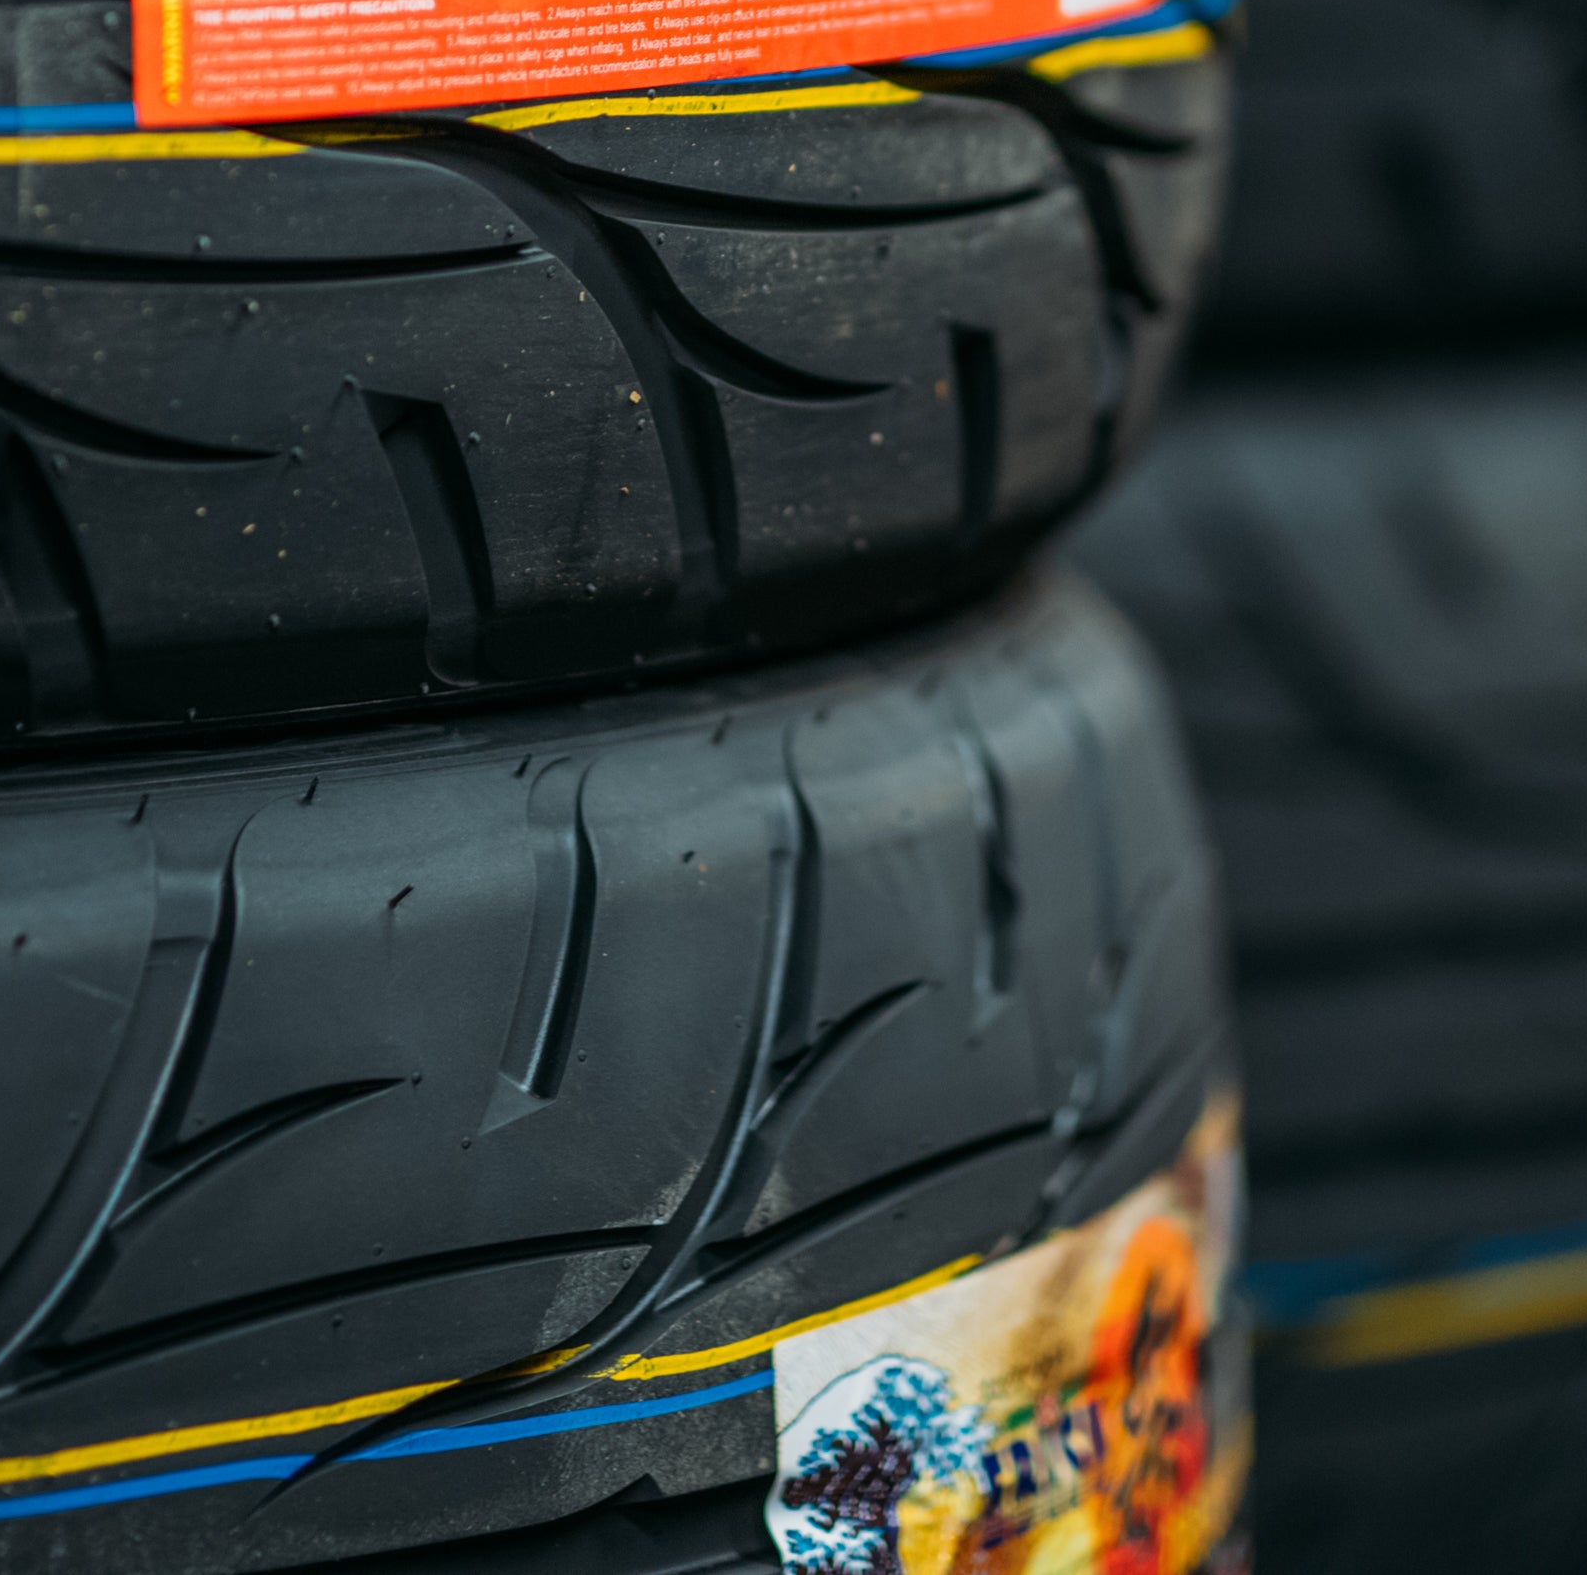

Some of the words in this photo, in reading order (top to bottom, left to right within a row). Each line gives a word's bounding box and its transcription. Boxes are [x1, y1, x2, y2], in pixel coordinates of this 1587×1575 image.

[298, 2, 346, 20] SAFETY
[466, 12, 483, 26] and
[486, 10, 519, 25] inflating
[547, 5, 585, 20] 2.Always
[587, 1, 612, 16] match
[614, 0, 627, 14] rim
[515, 27, 532, 41] and
[533, 24, 570, 40] lubricate
[572, 23, 585, 36] rim
[587, 21, 603, 35] and
[605, 20, 618, 34] tire
[620, 18, 647, 32] beads.
[653, 15, 689, 30] 6.Always
[690, 15, 704, 26] use
[755, 5, 770, 19] and
[478, 50, 503, 67] place
[516, 46, 541, 62] safety
[543, 47, 563, 60] cage
[566, 43, 588, 56] when
[591, 39, 625, 55] inflating.
[632, 36, 667, 51] 8.Always
[669, 32, 691, 47] stand
[717, 28, 731, 42] and
[496, 67, 527, 82] vehicle
[528, 62, 588, 79] manufacture's
[590, 56, 657, 74] recommendation
[658, 54, 676, 68] after
[677, 51, 701, 66] beads
[703, 53, 716, 63] are
[717, 48, 732, 64] fully
